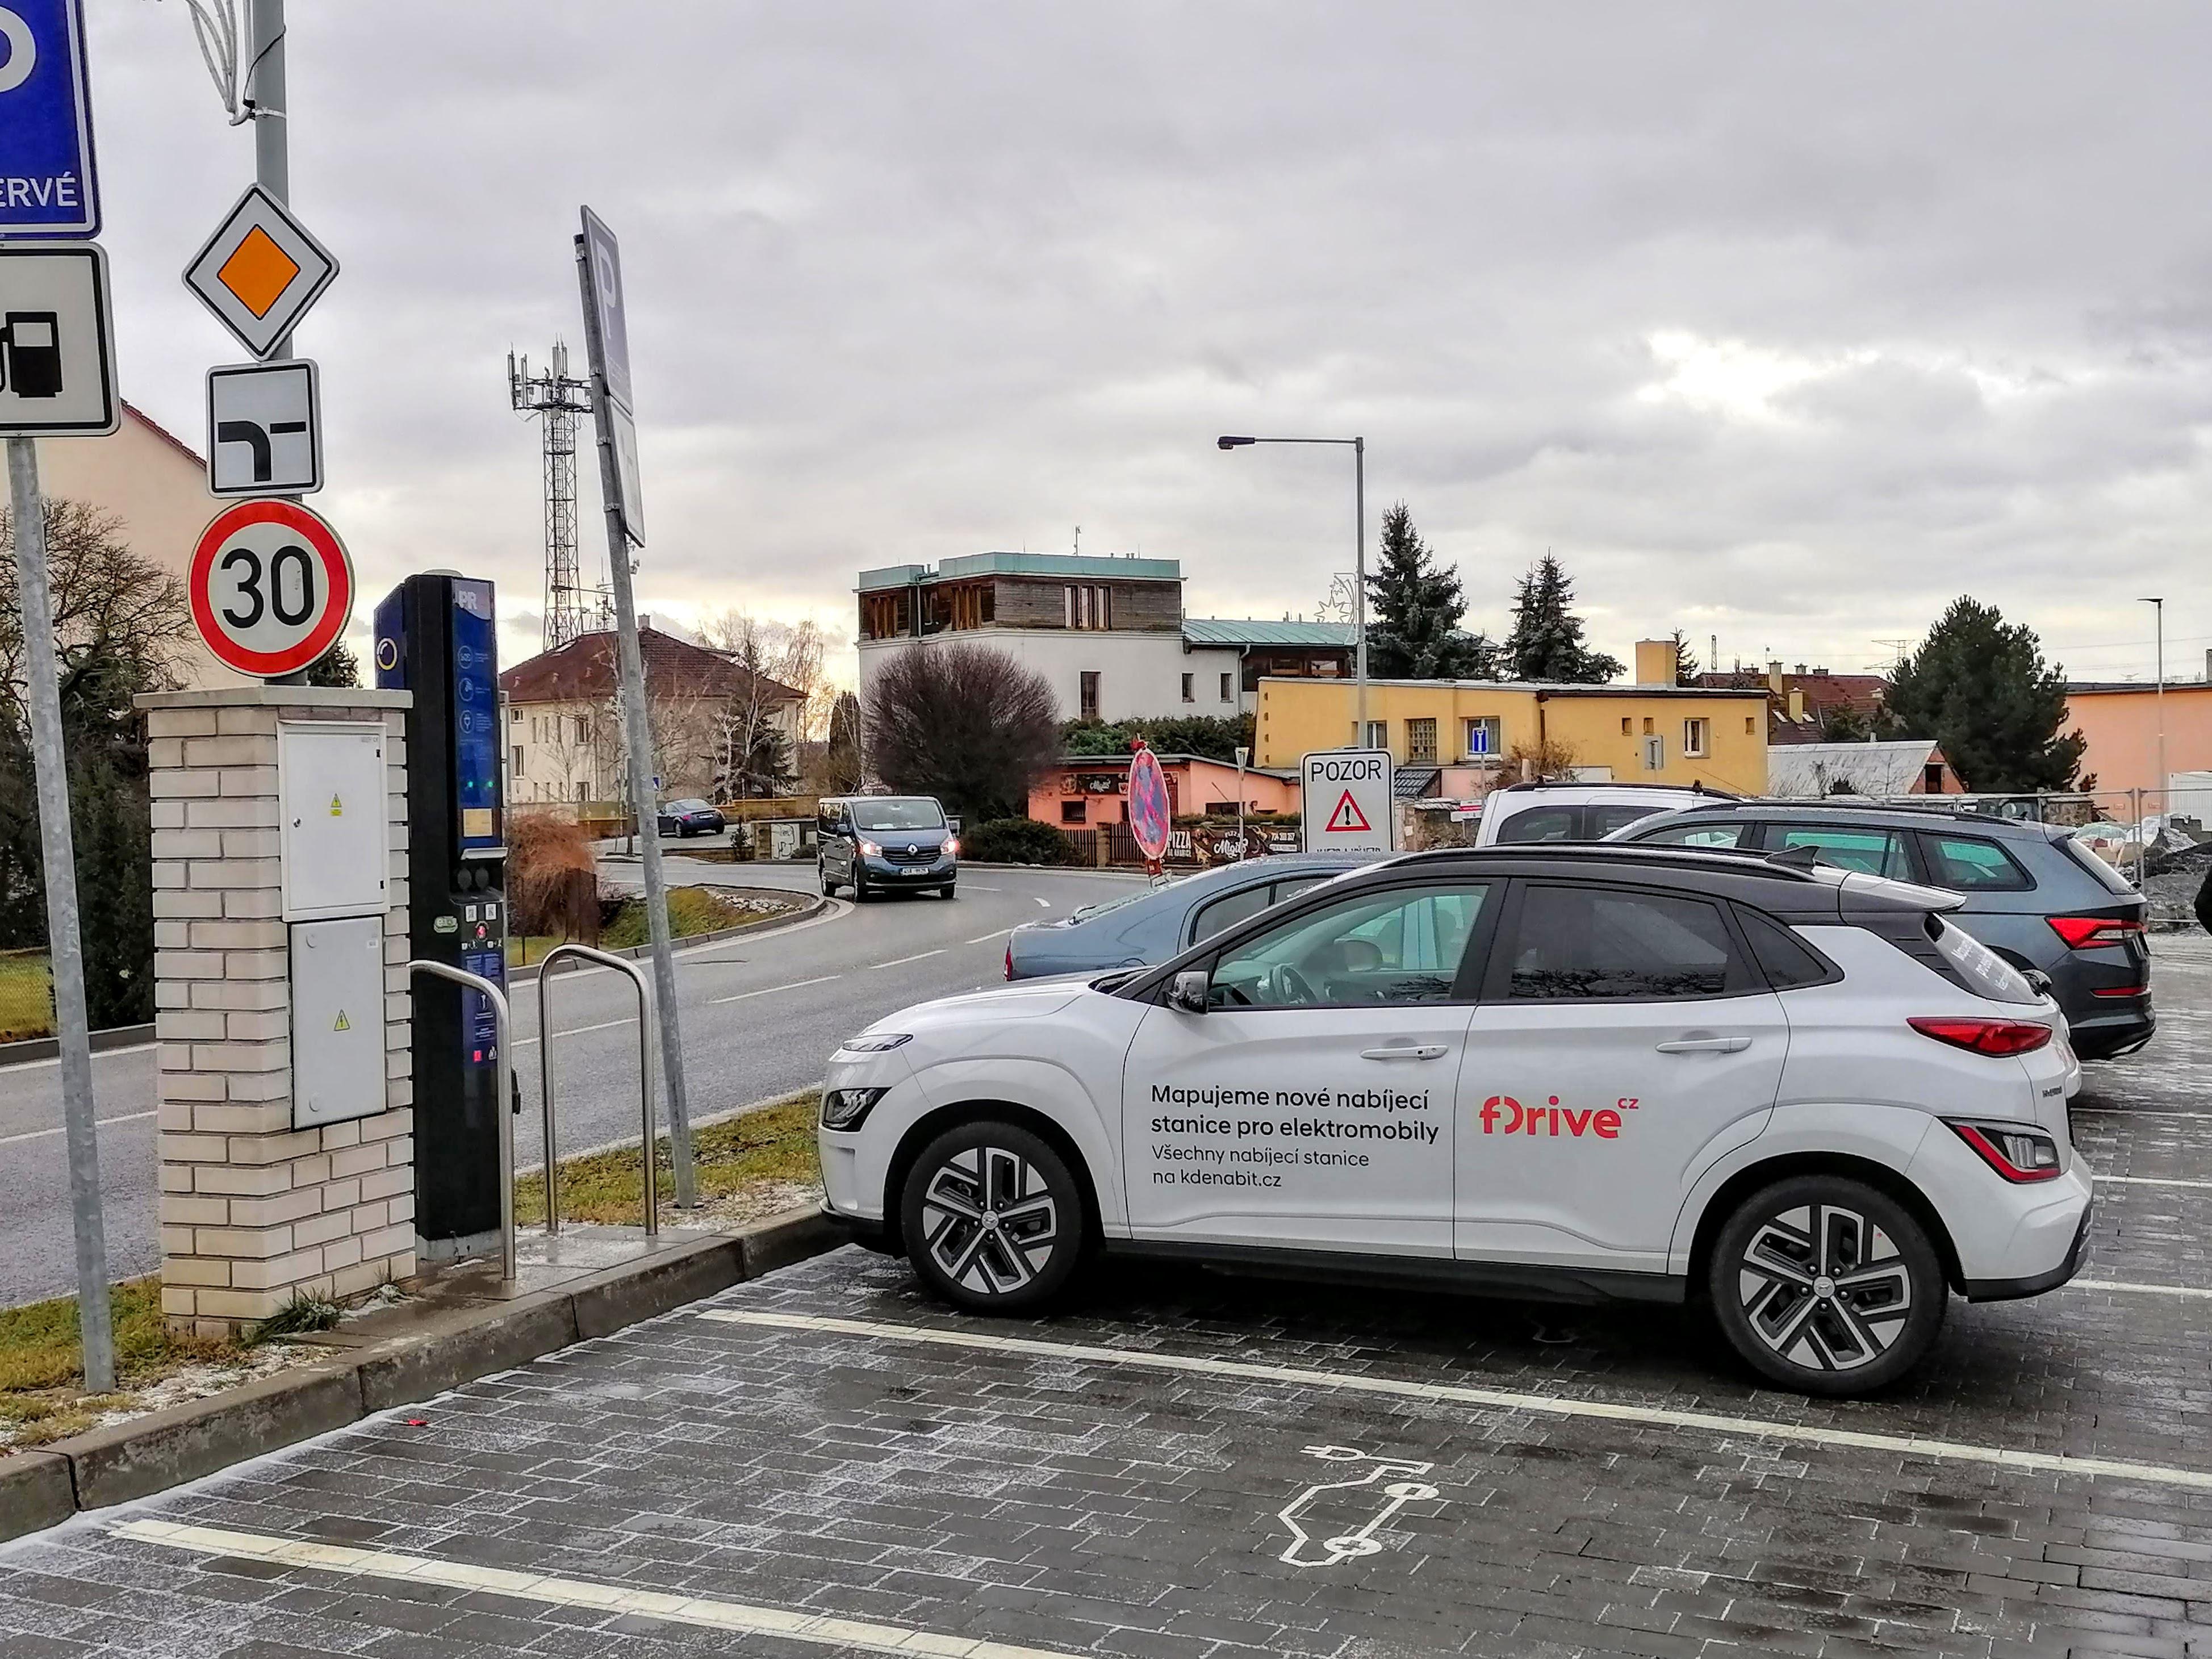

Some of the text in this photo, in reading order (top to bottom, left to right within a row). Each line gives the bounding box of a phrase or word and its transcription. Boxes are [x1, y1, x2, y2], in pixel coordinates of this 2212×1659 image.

[221, 546, 314, 629] 30
[1311, 759, 1382, 782] POZOR
[1152, 1085, 1429, 1113] Mapujeme nové nabíjecí
[1151, 1114, 1439, 1145] stanice pro elektromobily
[1152, 1143, 1369, 1167] Všechny nabíjecí stanice
[1153, 1168, 1282, 1187] na kdenabit.cz
